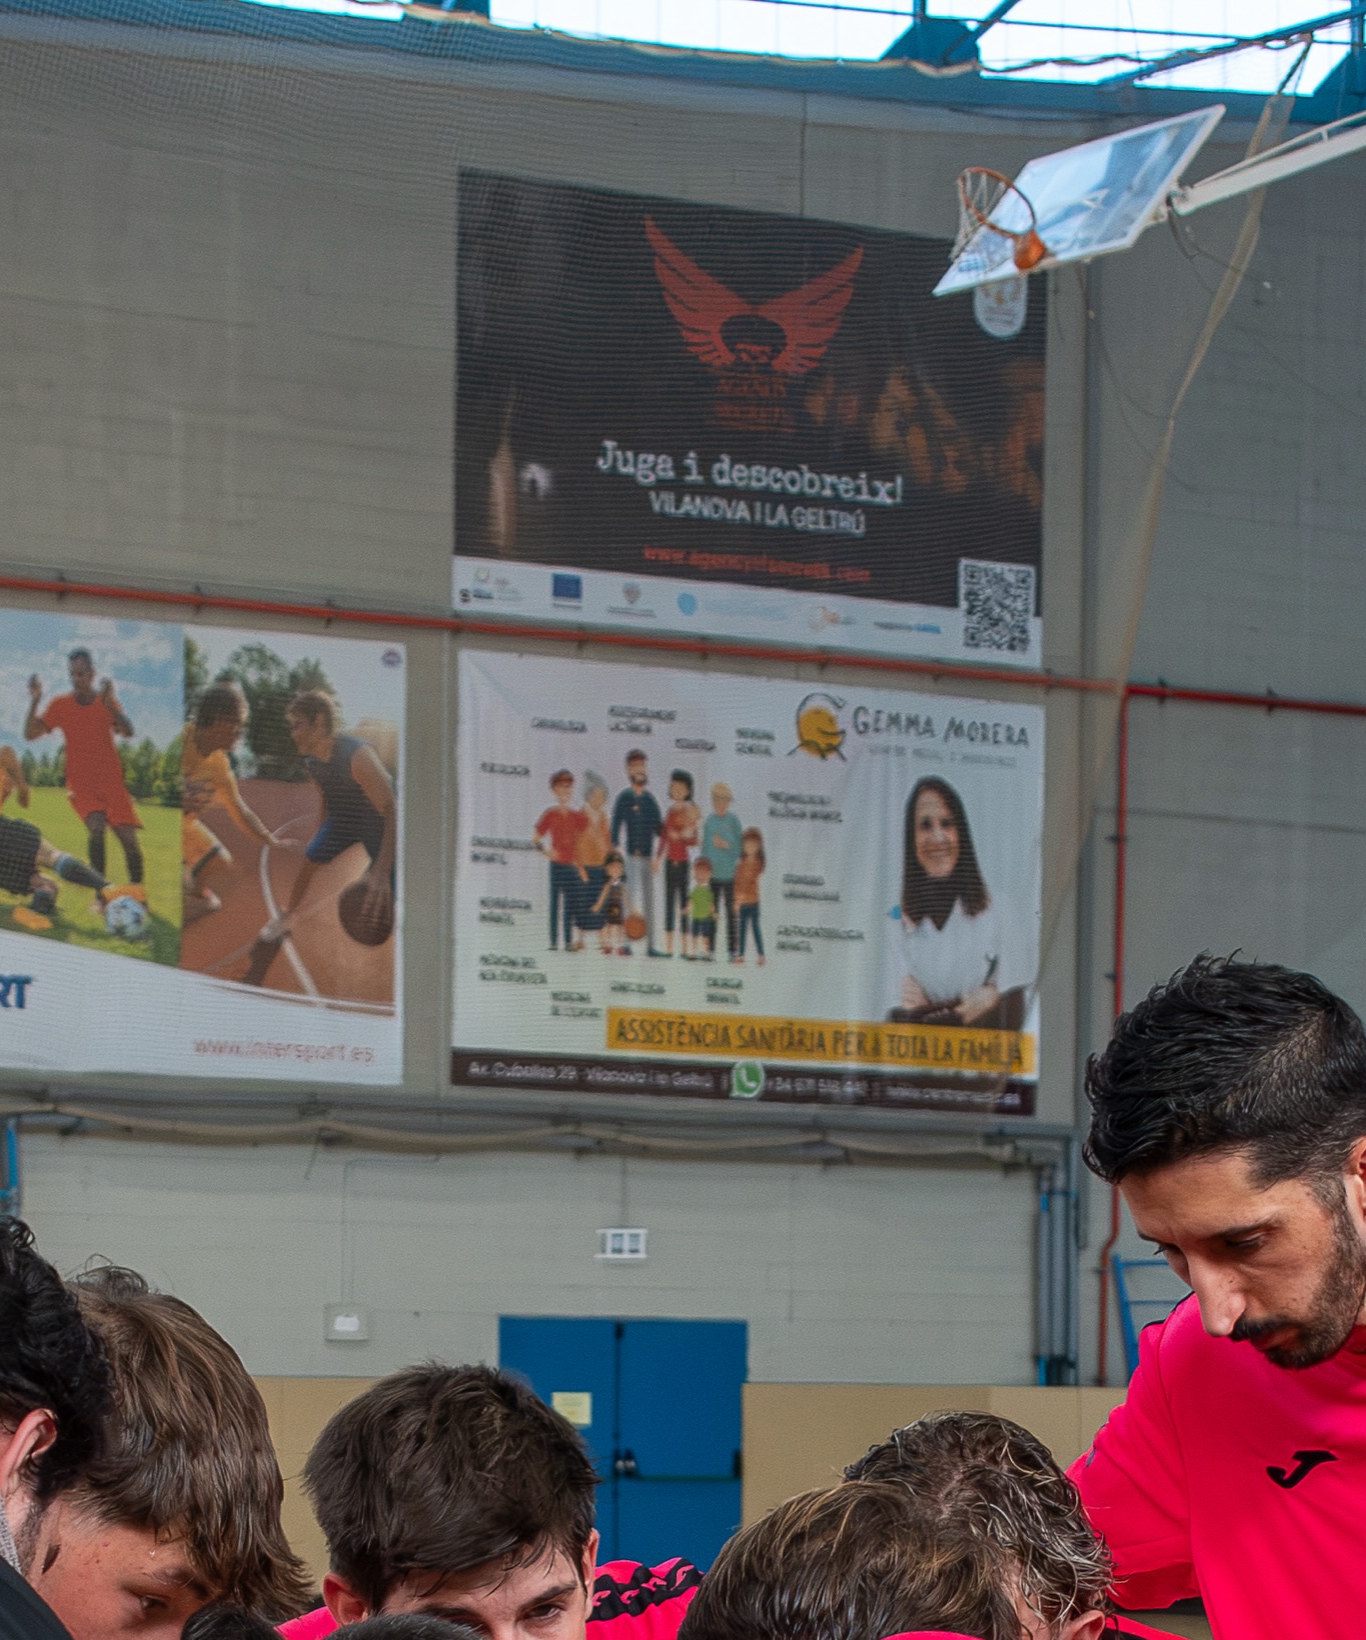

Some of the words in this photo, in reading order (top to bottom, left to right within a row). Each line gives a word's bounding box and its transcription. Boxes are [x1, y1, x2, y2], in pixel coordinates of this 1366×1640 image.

[596, 440, 676, 486] Juga
[683, 451, 704, 485] i
[711, 453, 904, 506] descobreix!
[649, 490, 750, 523] VILANOVA
[765, 503, 789, 527] LA
[852, 706, 937, 737] GEMMA
[943, 715, 1031, 748] MORERA
[617, 1015, 732, 1048] ASSISTÈNCIA
[832, 1029, 867, 1057] PER
[886, 1033, 929, 1061] TOTA
[934, 1037, 954, 1062] LA
